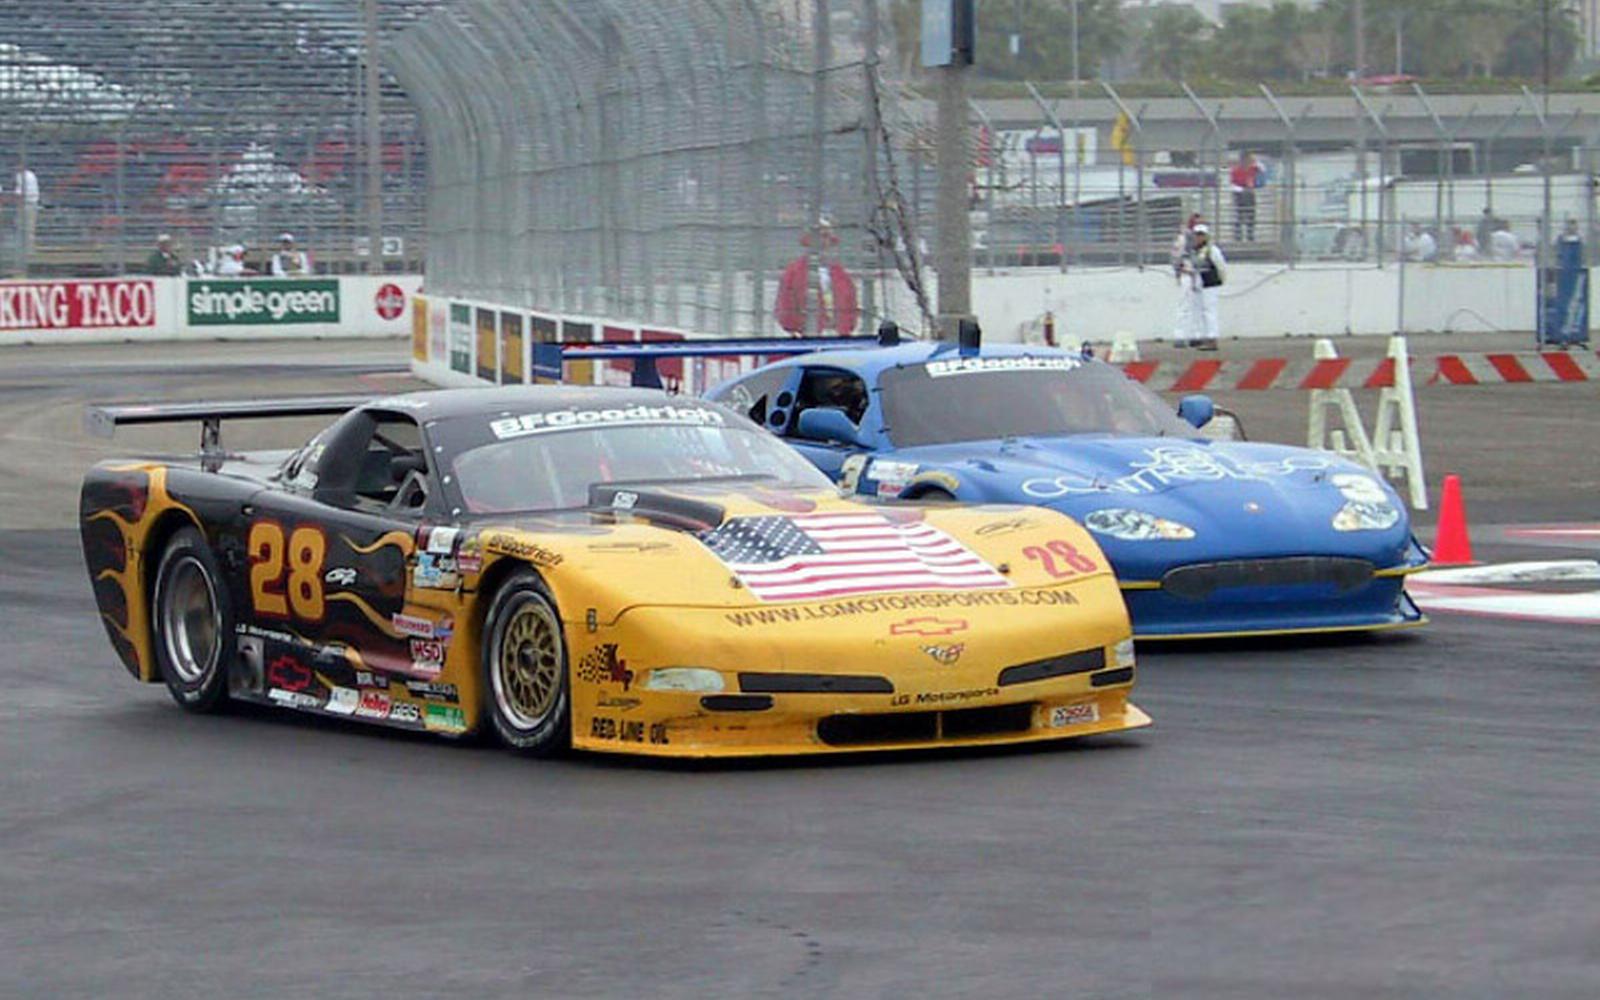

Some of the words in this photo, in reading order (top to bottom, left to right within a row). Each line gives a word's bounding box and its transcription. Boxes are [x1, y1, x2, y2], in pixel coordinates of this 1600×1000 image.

[0, 285, 69, 328] KING
[75, 282, 154, 327] TACO
[191, 285, 262, 320] simple
[262, 289, 335, 320] green
[490, 404, 724, 435] BFGoodrich
[249, 519, 326, 620] 28
[1022, 539, 1097, 578] 28
[726, 590, 1079, 628] WWW.LGMOTORSPORTS.COM
[891, 694, 910, 707] LG
[916, 687, 999, 704] Motorsports
[591, 717, 617, 740] RED
[620, 719, 645, 742] LINE
[650, 722, 670, 744] OIL
